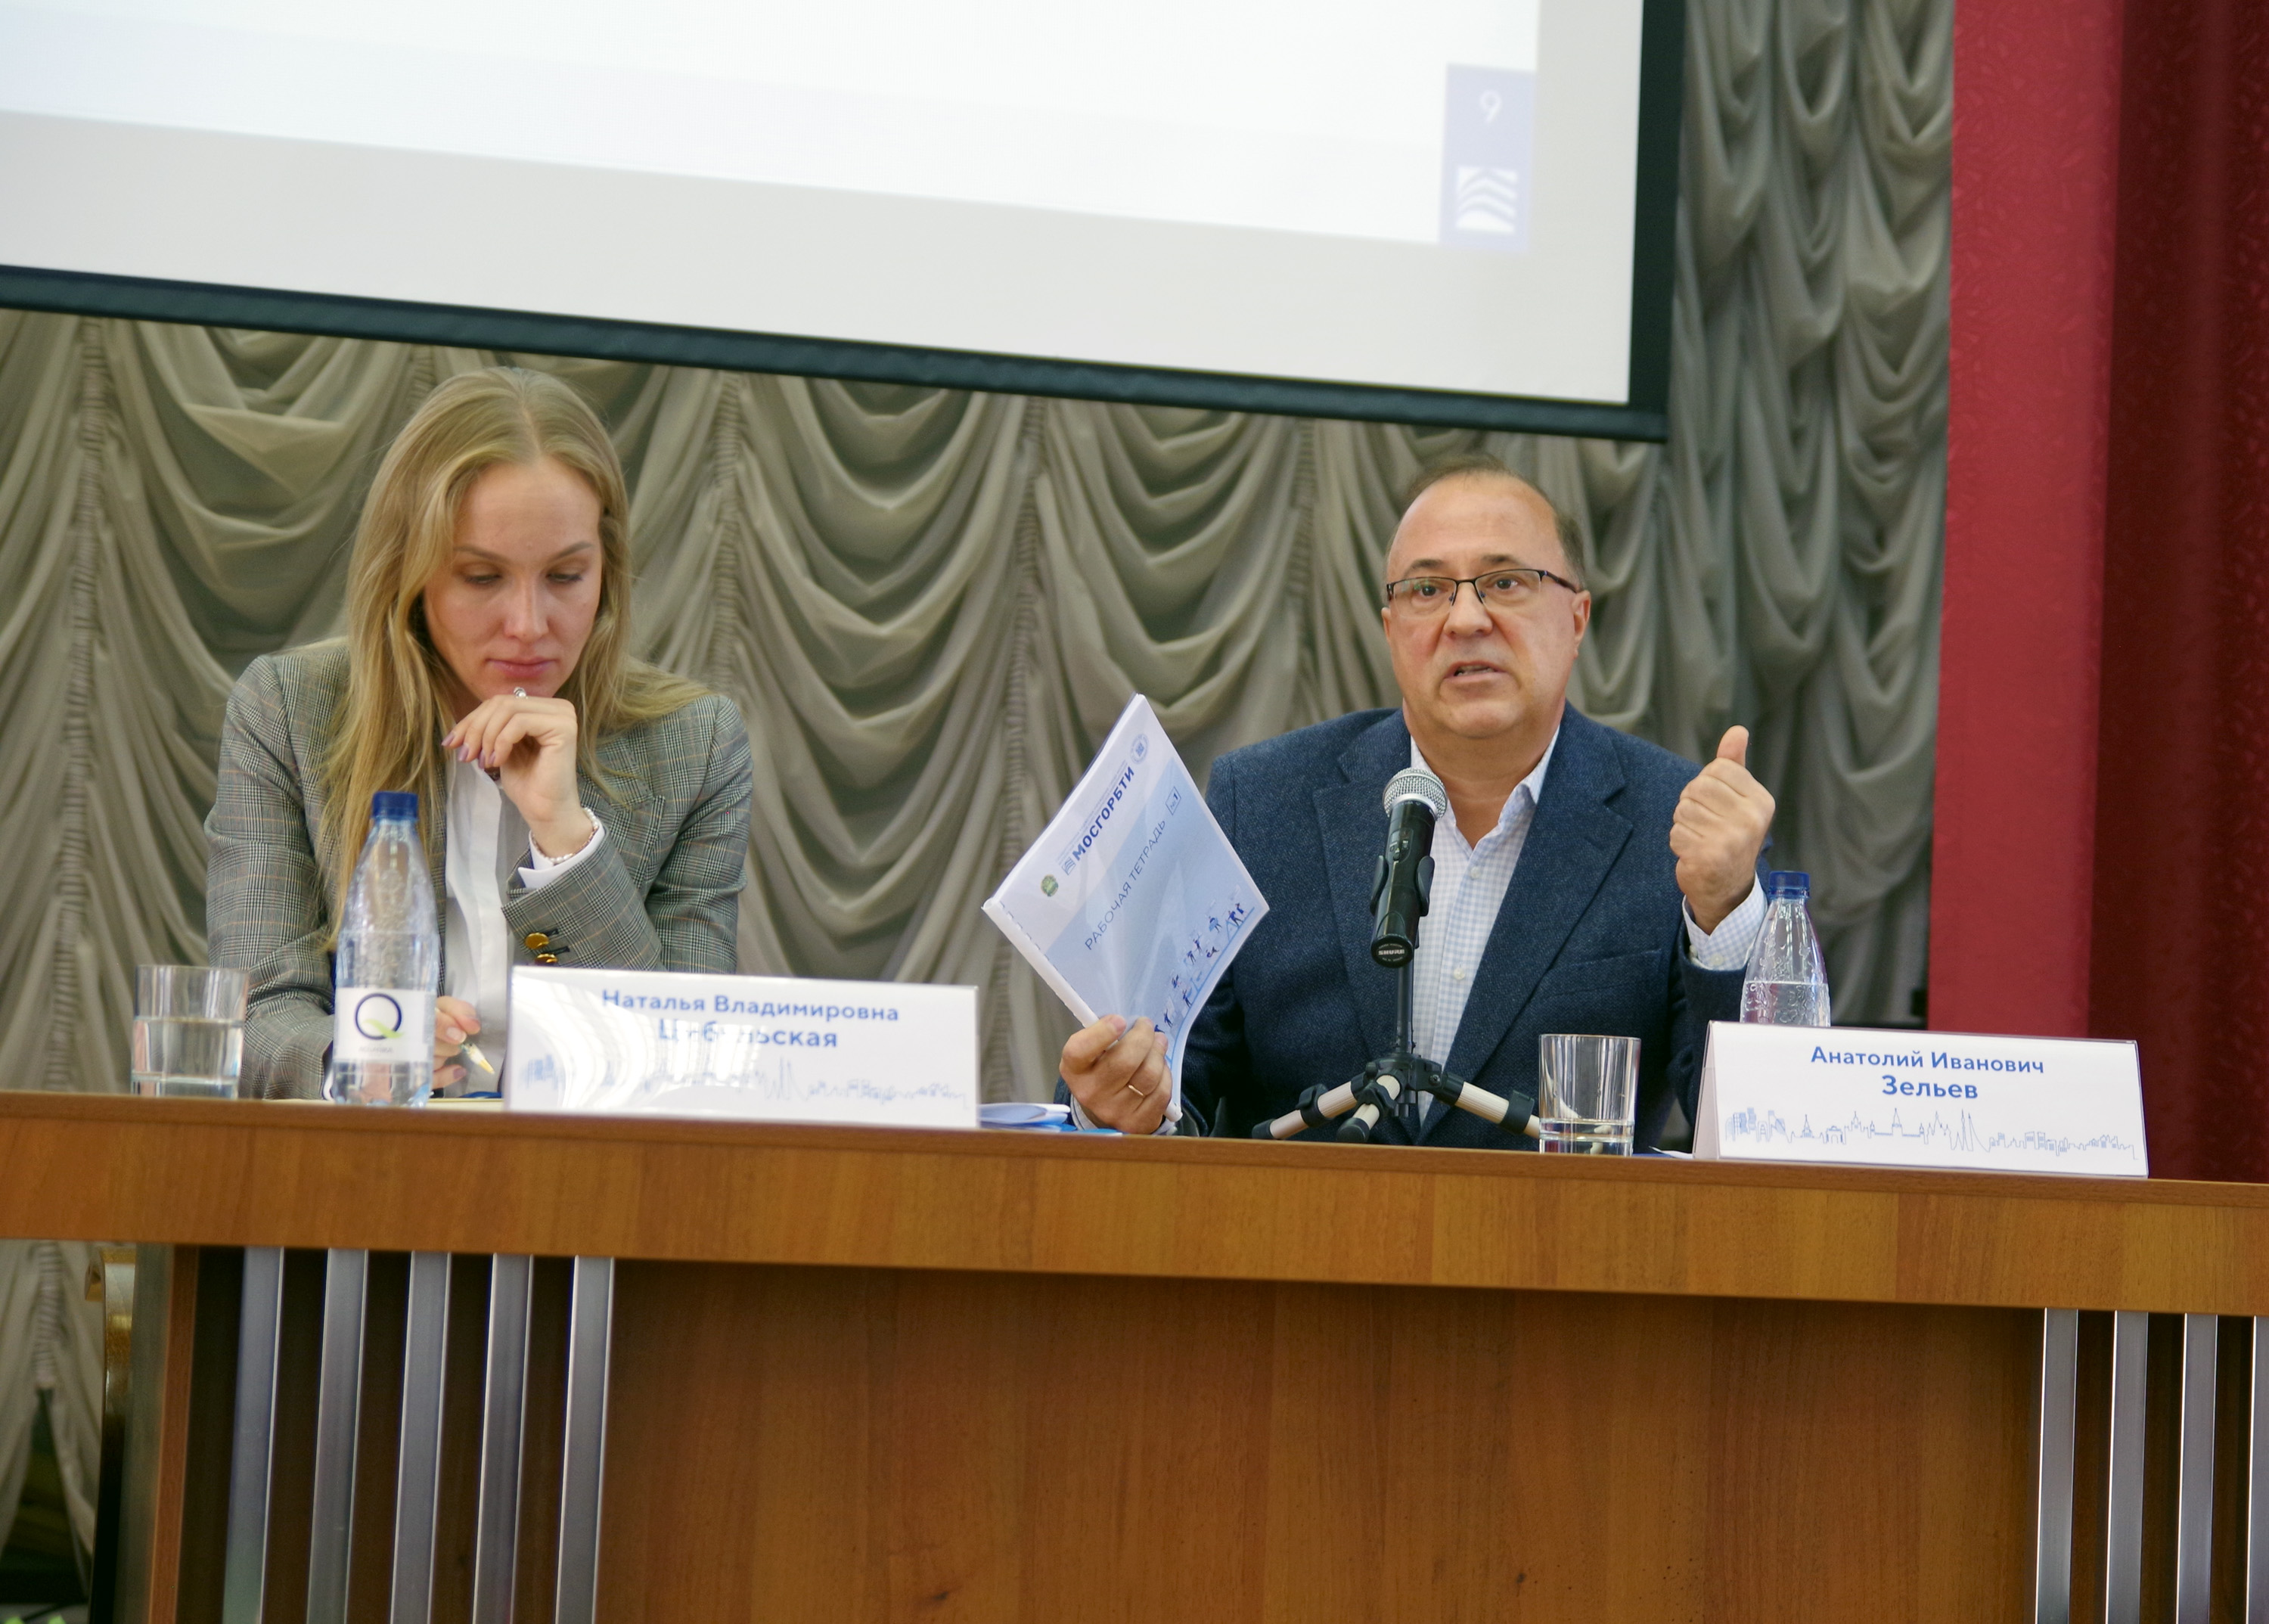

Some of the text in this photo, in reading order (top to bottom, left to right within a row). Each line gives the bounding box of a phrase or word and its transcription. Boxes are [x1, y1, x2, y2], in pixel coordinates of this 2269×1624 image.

[1479, 89, 1502, 123] 9
[1072, 765, 1135, 861] МОСГОРБТИ
[1085, 881, 1131, 950] РАБОЧАЯ
[1128, 820, 1166, 881] ТЕТРАДЬ
[602, 989, 899, 1022] Наталья Владимировна
[1811, 1045, 2044, 1074] Анатолий Иванович
[1882, 1074, 1979, 1099] Зельев
